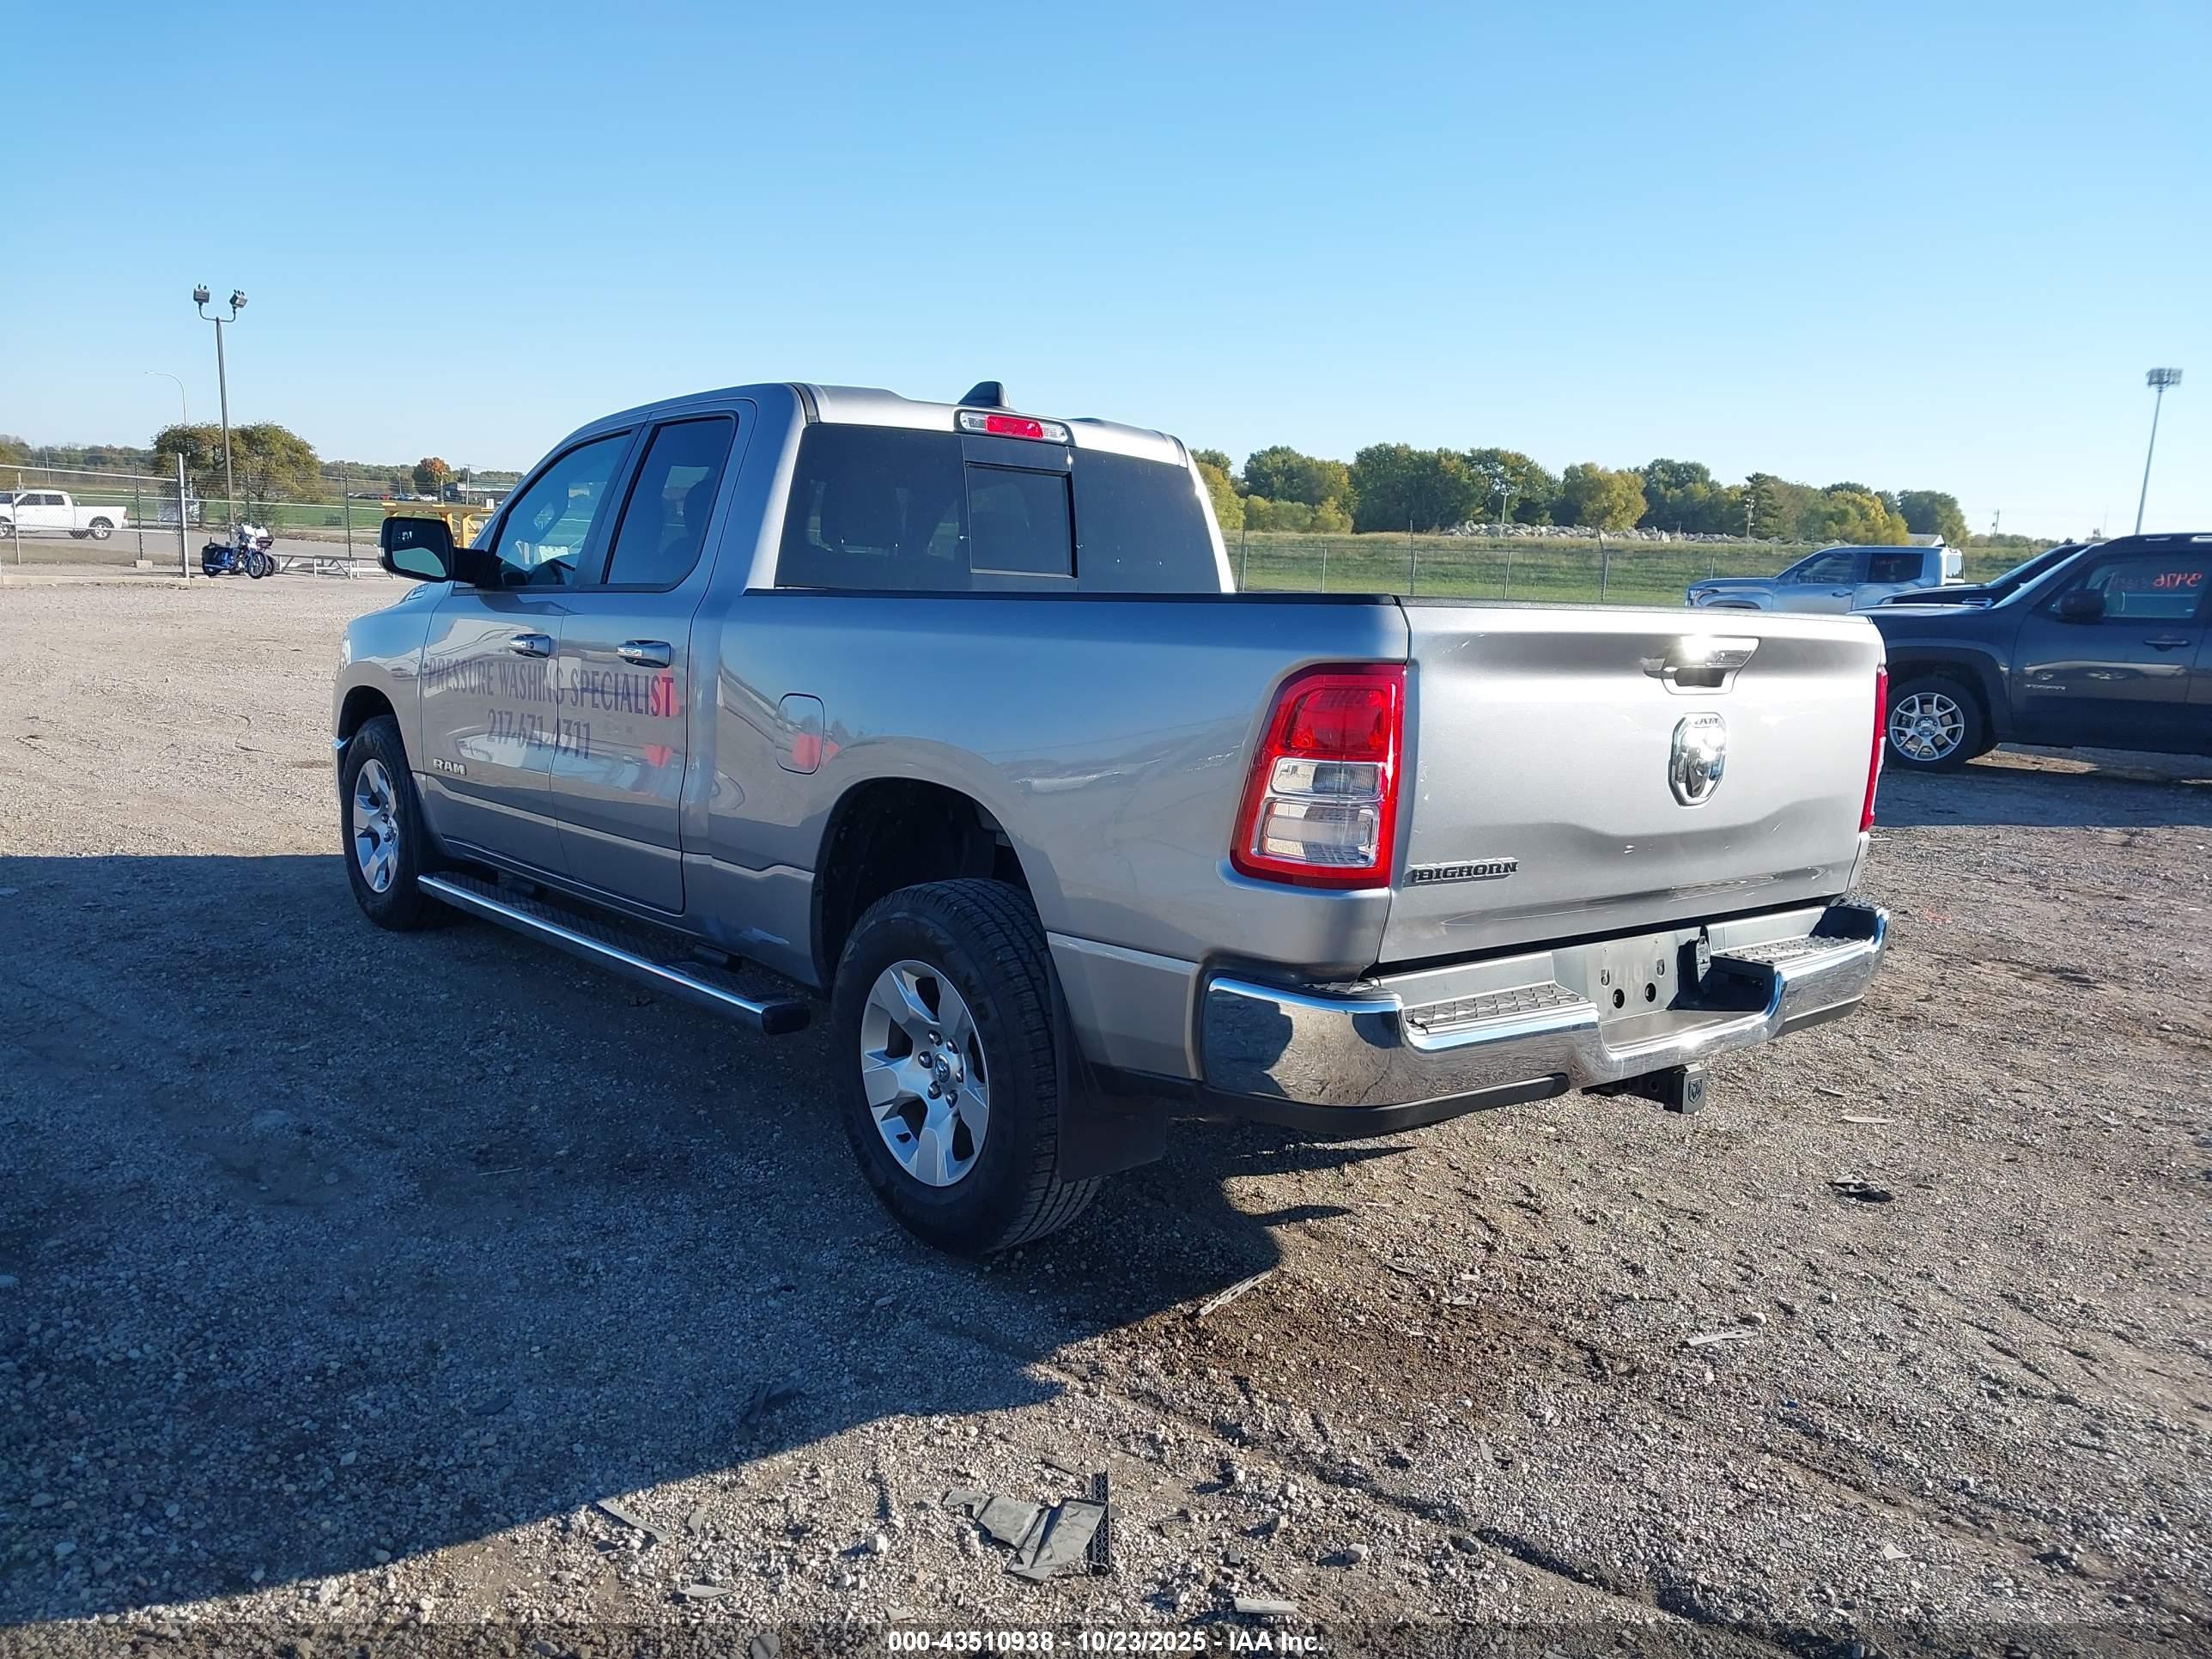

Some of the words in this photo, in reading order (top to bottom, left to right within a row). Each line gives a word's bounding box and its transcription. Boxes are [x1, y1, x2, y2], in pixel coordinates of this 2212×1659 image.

[428, 657, 495, 696] PRESSURE
[498, 663, 564, 705] WASHING
[570, 667, 674, 718] SPECIALIST
[433, 757, 466, 775] RAM
[1413, 860, 1519, 882] BIGHORN
